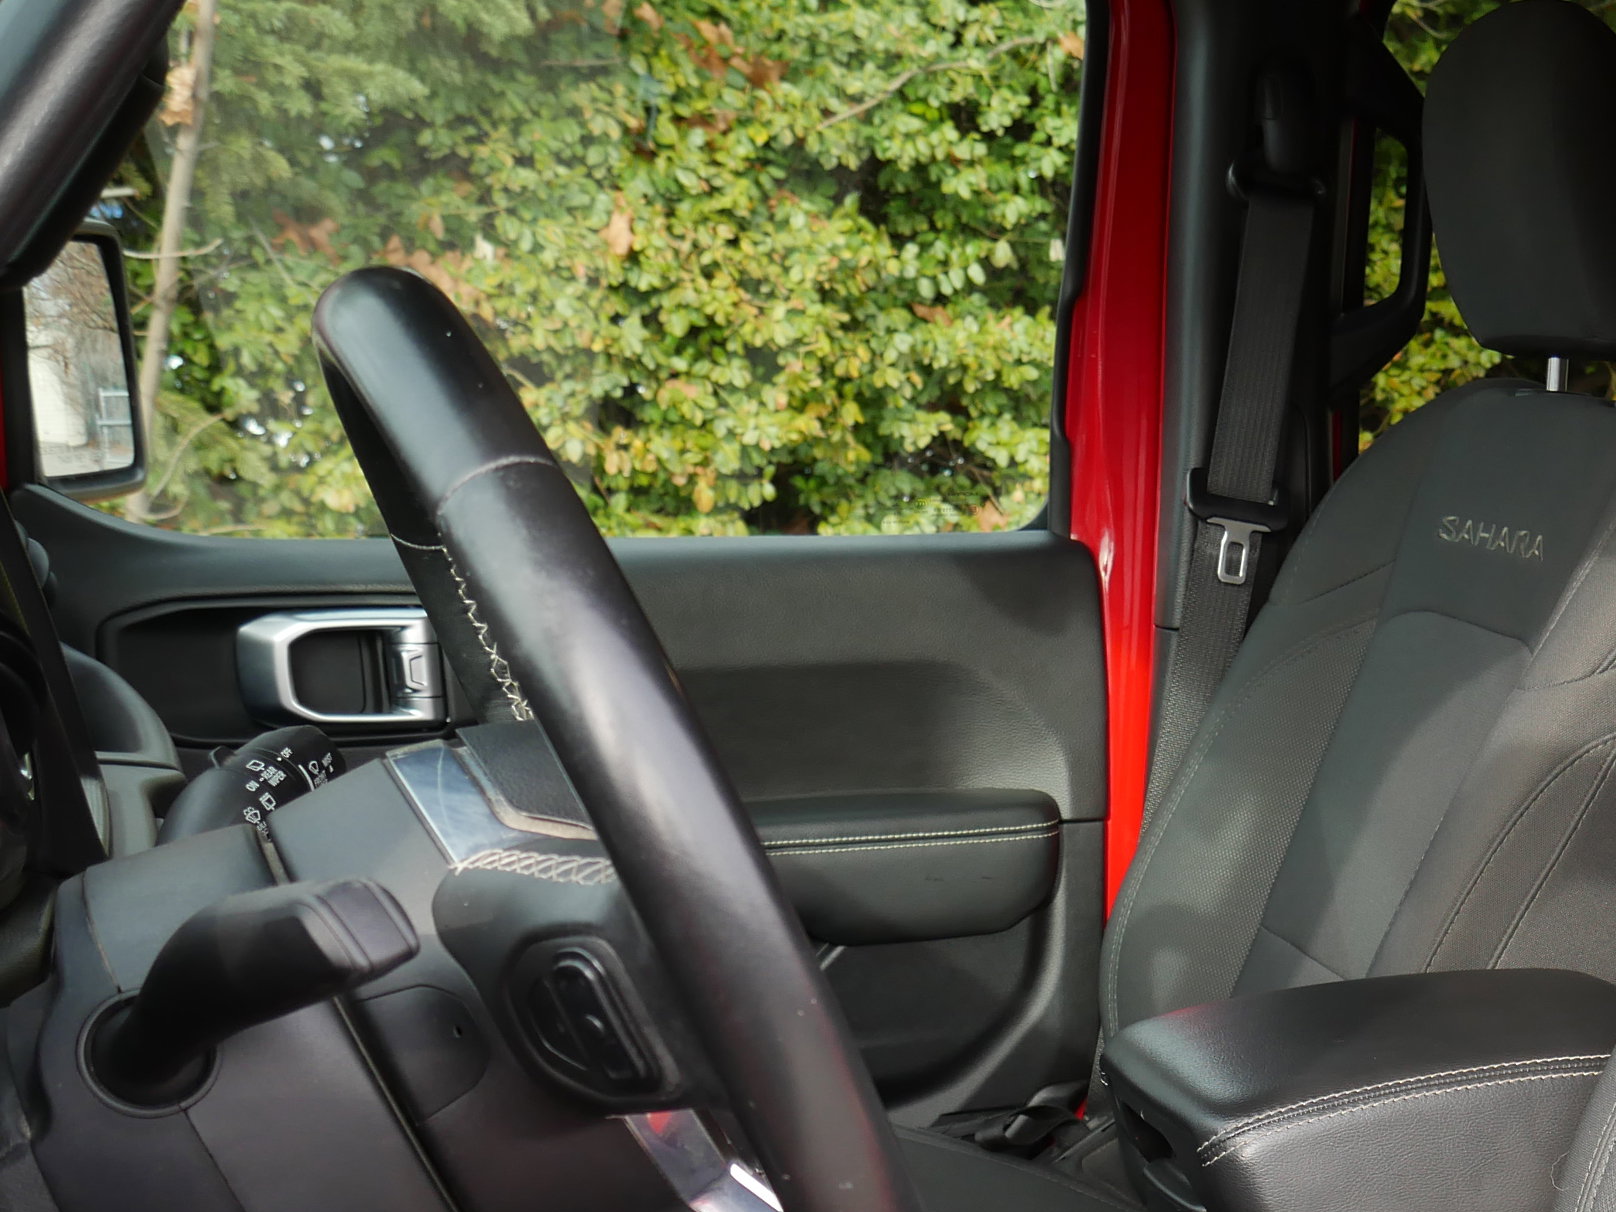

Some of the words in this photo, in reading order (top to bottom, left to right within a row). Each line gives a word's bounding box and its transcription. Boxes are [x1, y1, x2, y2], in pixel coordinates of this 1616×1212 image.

[1438, 516, 1544, 562] SAHARA
[281, 747, 293, 758] OFF
[246, 780, 260, 792] ON
